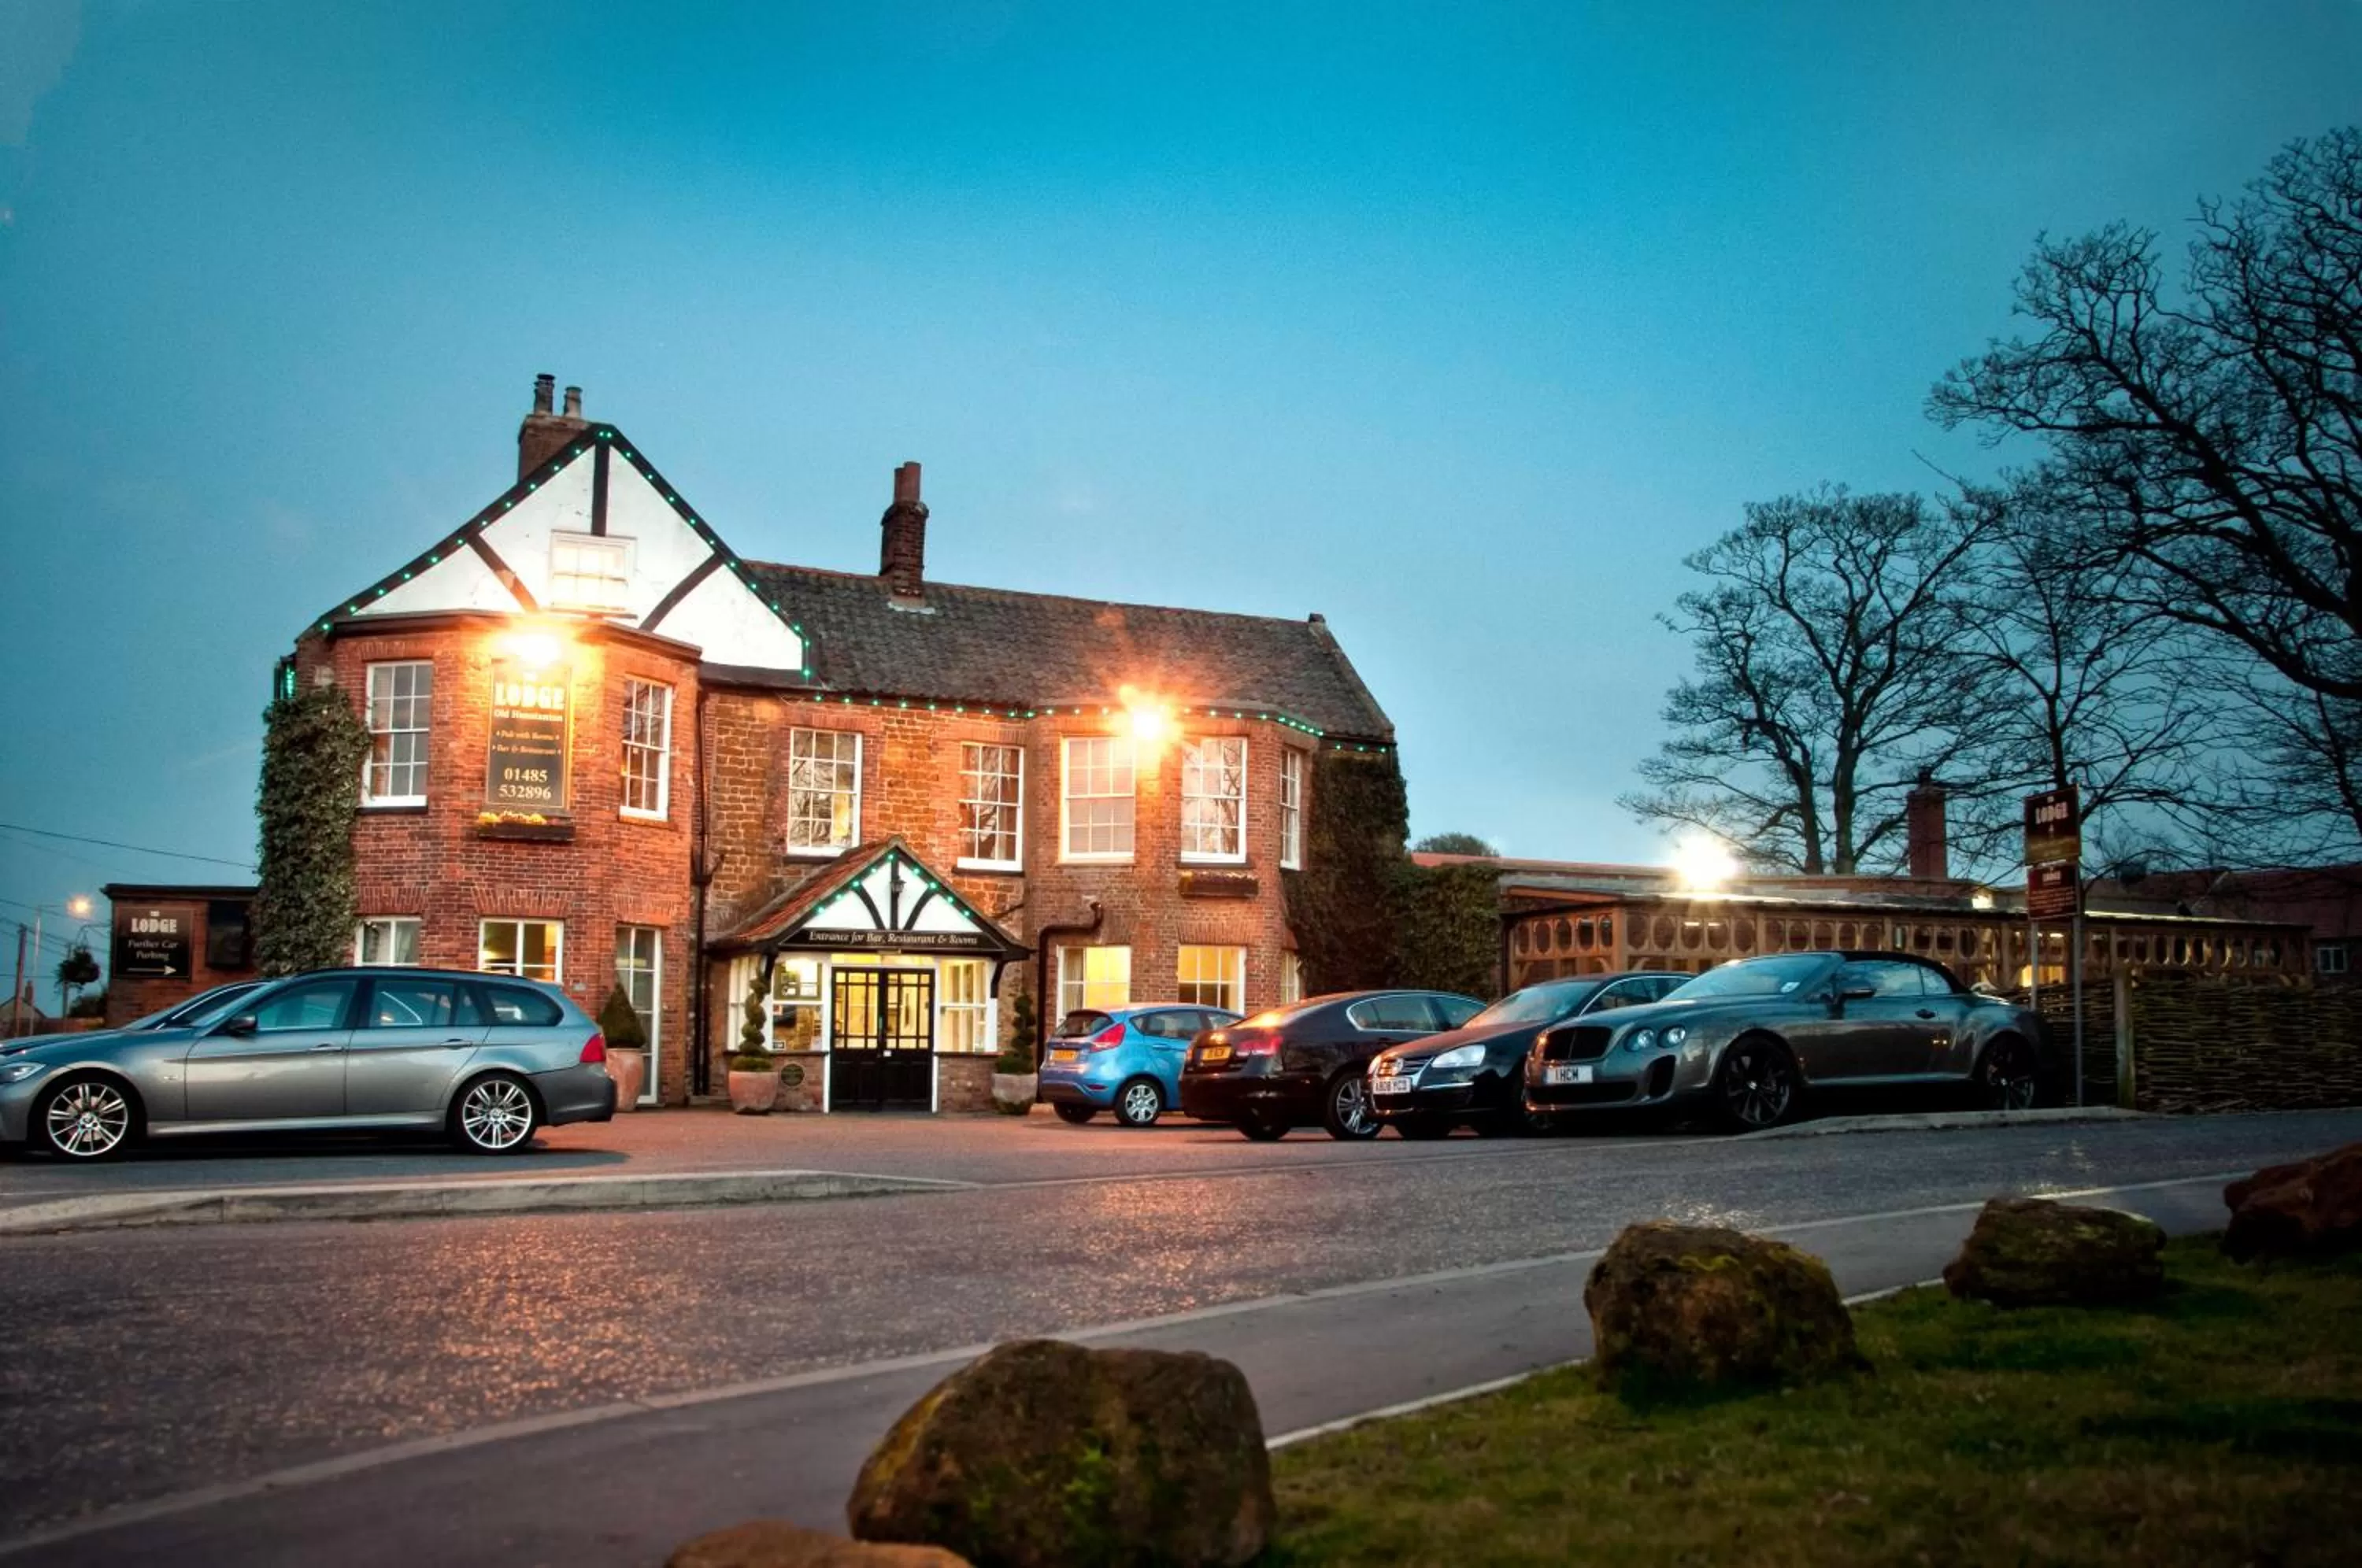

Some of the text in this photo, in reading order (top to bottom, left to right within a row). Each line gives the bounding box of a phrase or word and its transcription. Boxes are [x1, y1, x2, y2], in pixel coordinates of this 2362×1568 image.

[494, 682, 565, 710] LODGE
[504, 767, 548, 782] 01485
[498, 784, 552, 800] 532896
[131, 918, 177, 933] LODGE
[128, 939, 179, 949] Further Car
[809, 930, 850, 941] Entrance
[850, 931, 864, 945] for
[887, 933, 935, 944] Restaurant
[949, 934, 978, 945] Rooms
[135, 950, 170, 961] Parking
